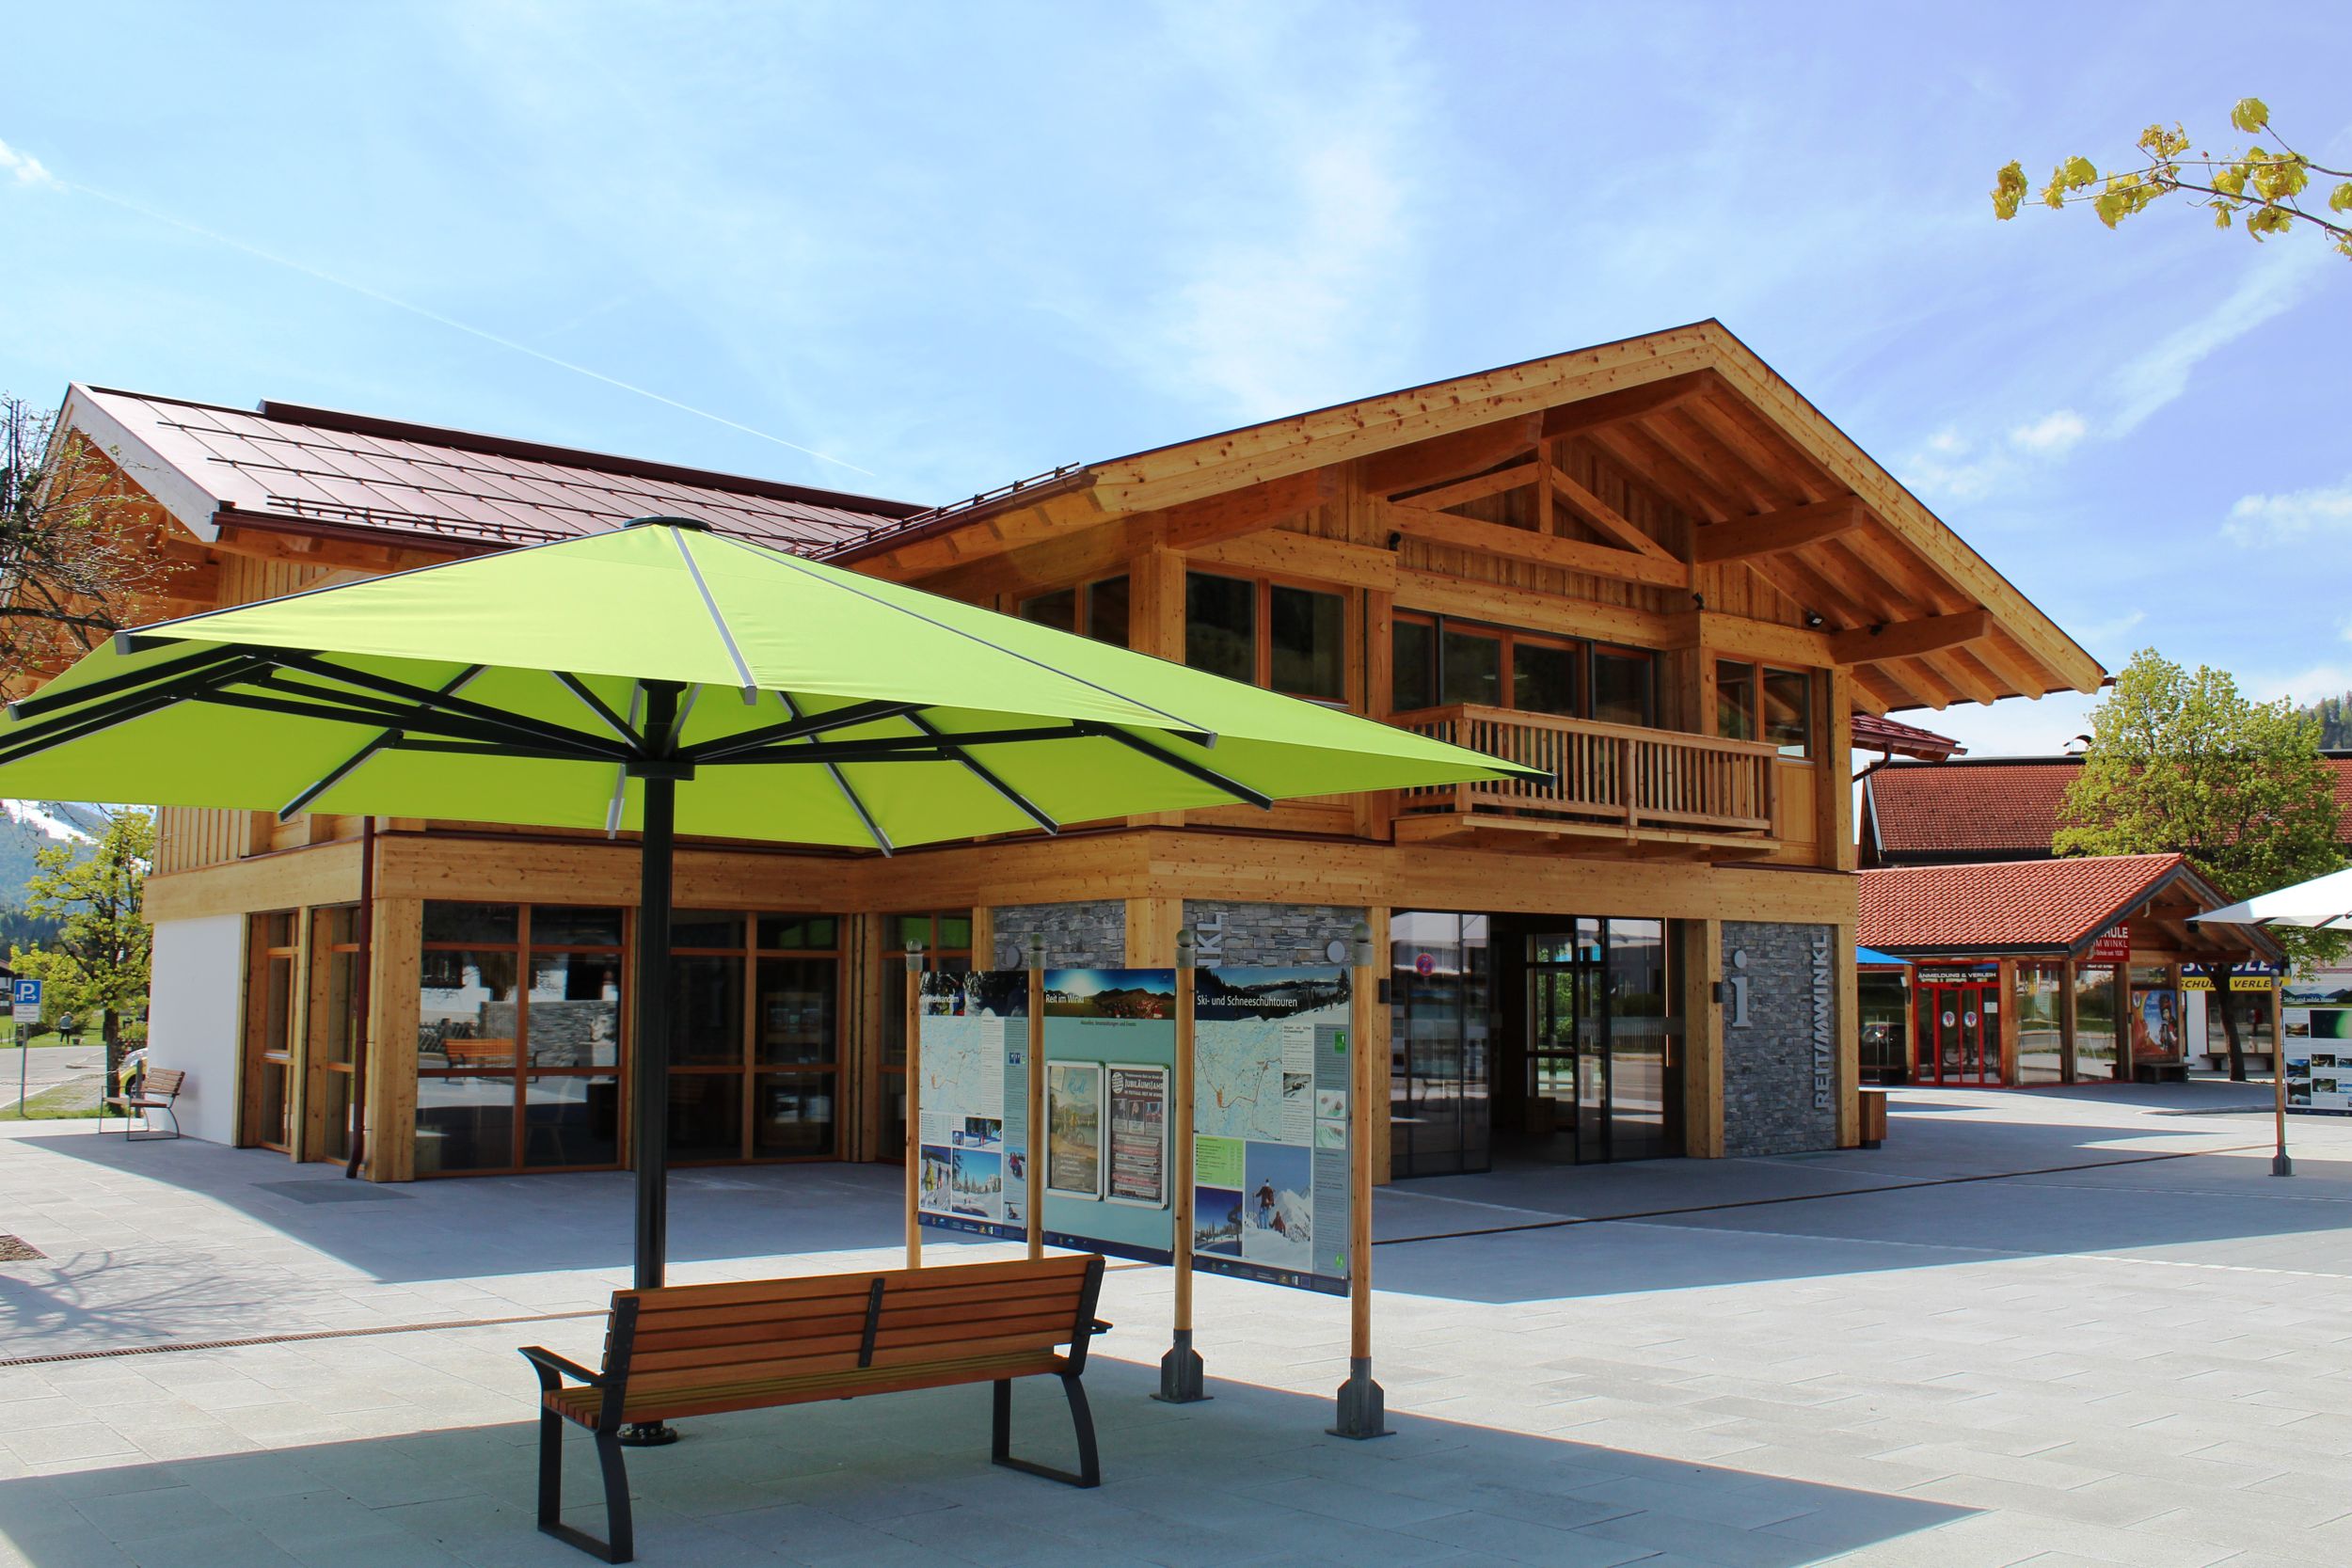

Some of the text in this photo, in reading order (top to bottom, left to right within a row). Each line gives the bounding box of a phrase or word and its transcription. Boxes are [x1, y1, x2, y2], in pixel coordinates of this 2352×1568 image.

[2104, 940, 2128, 948] WINKL
[20, 983, 36, 1002] P
[1045, 993, 1085, 1004] Reit im Winkl
[1197, 994, 1298, 1007] Ski- und Schneeschuhtouren
